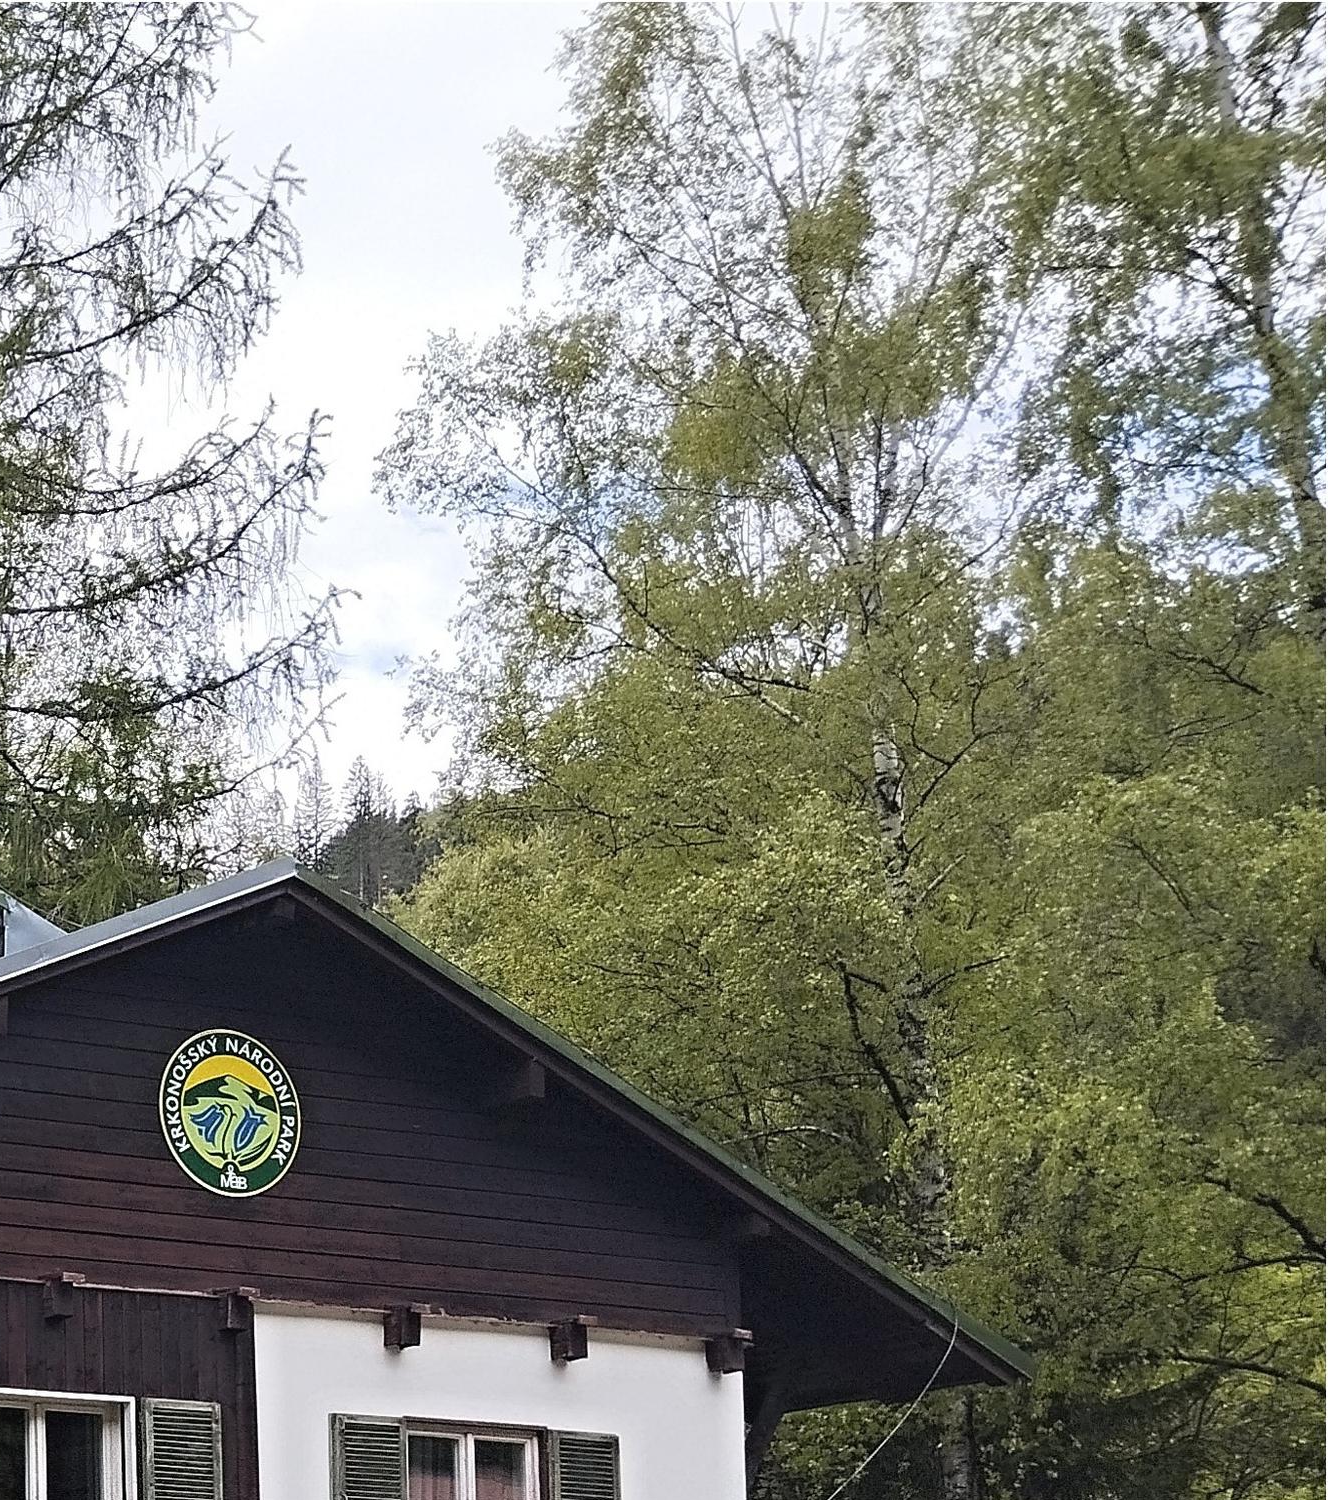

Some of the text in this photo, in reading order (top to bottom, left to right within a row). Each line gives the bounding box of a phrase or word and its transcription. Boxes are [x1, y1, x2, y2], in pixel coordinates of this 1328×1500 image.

[164, 1035, 296, 1166] KRKONOŠSKÝ NÁRODNÍ PARK
